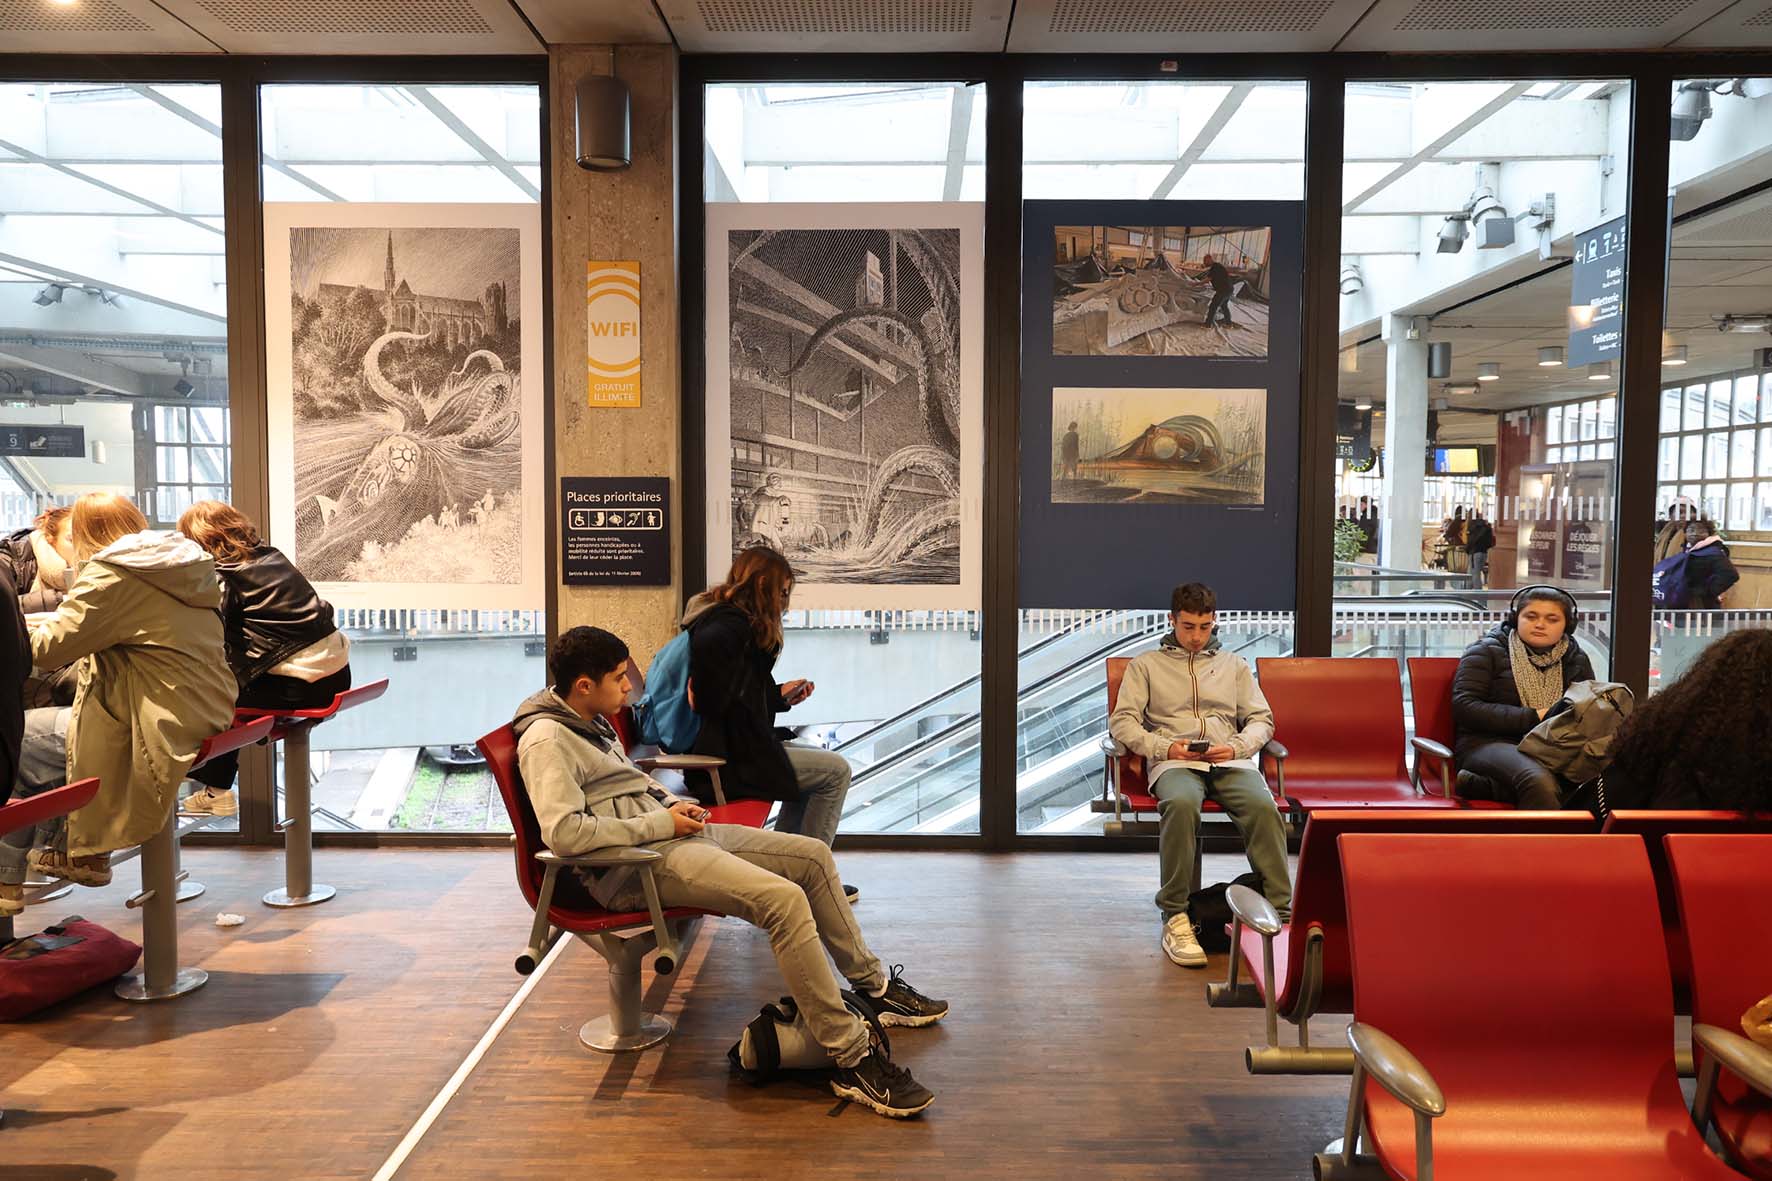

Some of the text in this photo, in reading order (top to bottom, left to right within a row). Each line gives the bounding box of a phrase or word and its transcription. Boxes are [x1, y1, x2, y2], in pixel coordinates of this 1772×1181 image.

[1606, 266, 1621, 279] Taxis
[591, 320, 637, 337] WIFI
[1592, 332, 1618, 345] Toilettes
[594, 383, 635, 392] GRATUIT
[10, 437, 17, 447] 9
[567, 491, 662, 504] Places prioritaires
